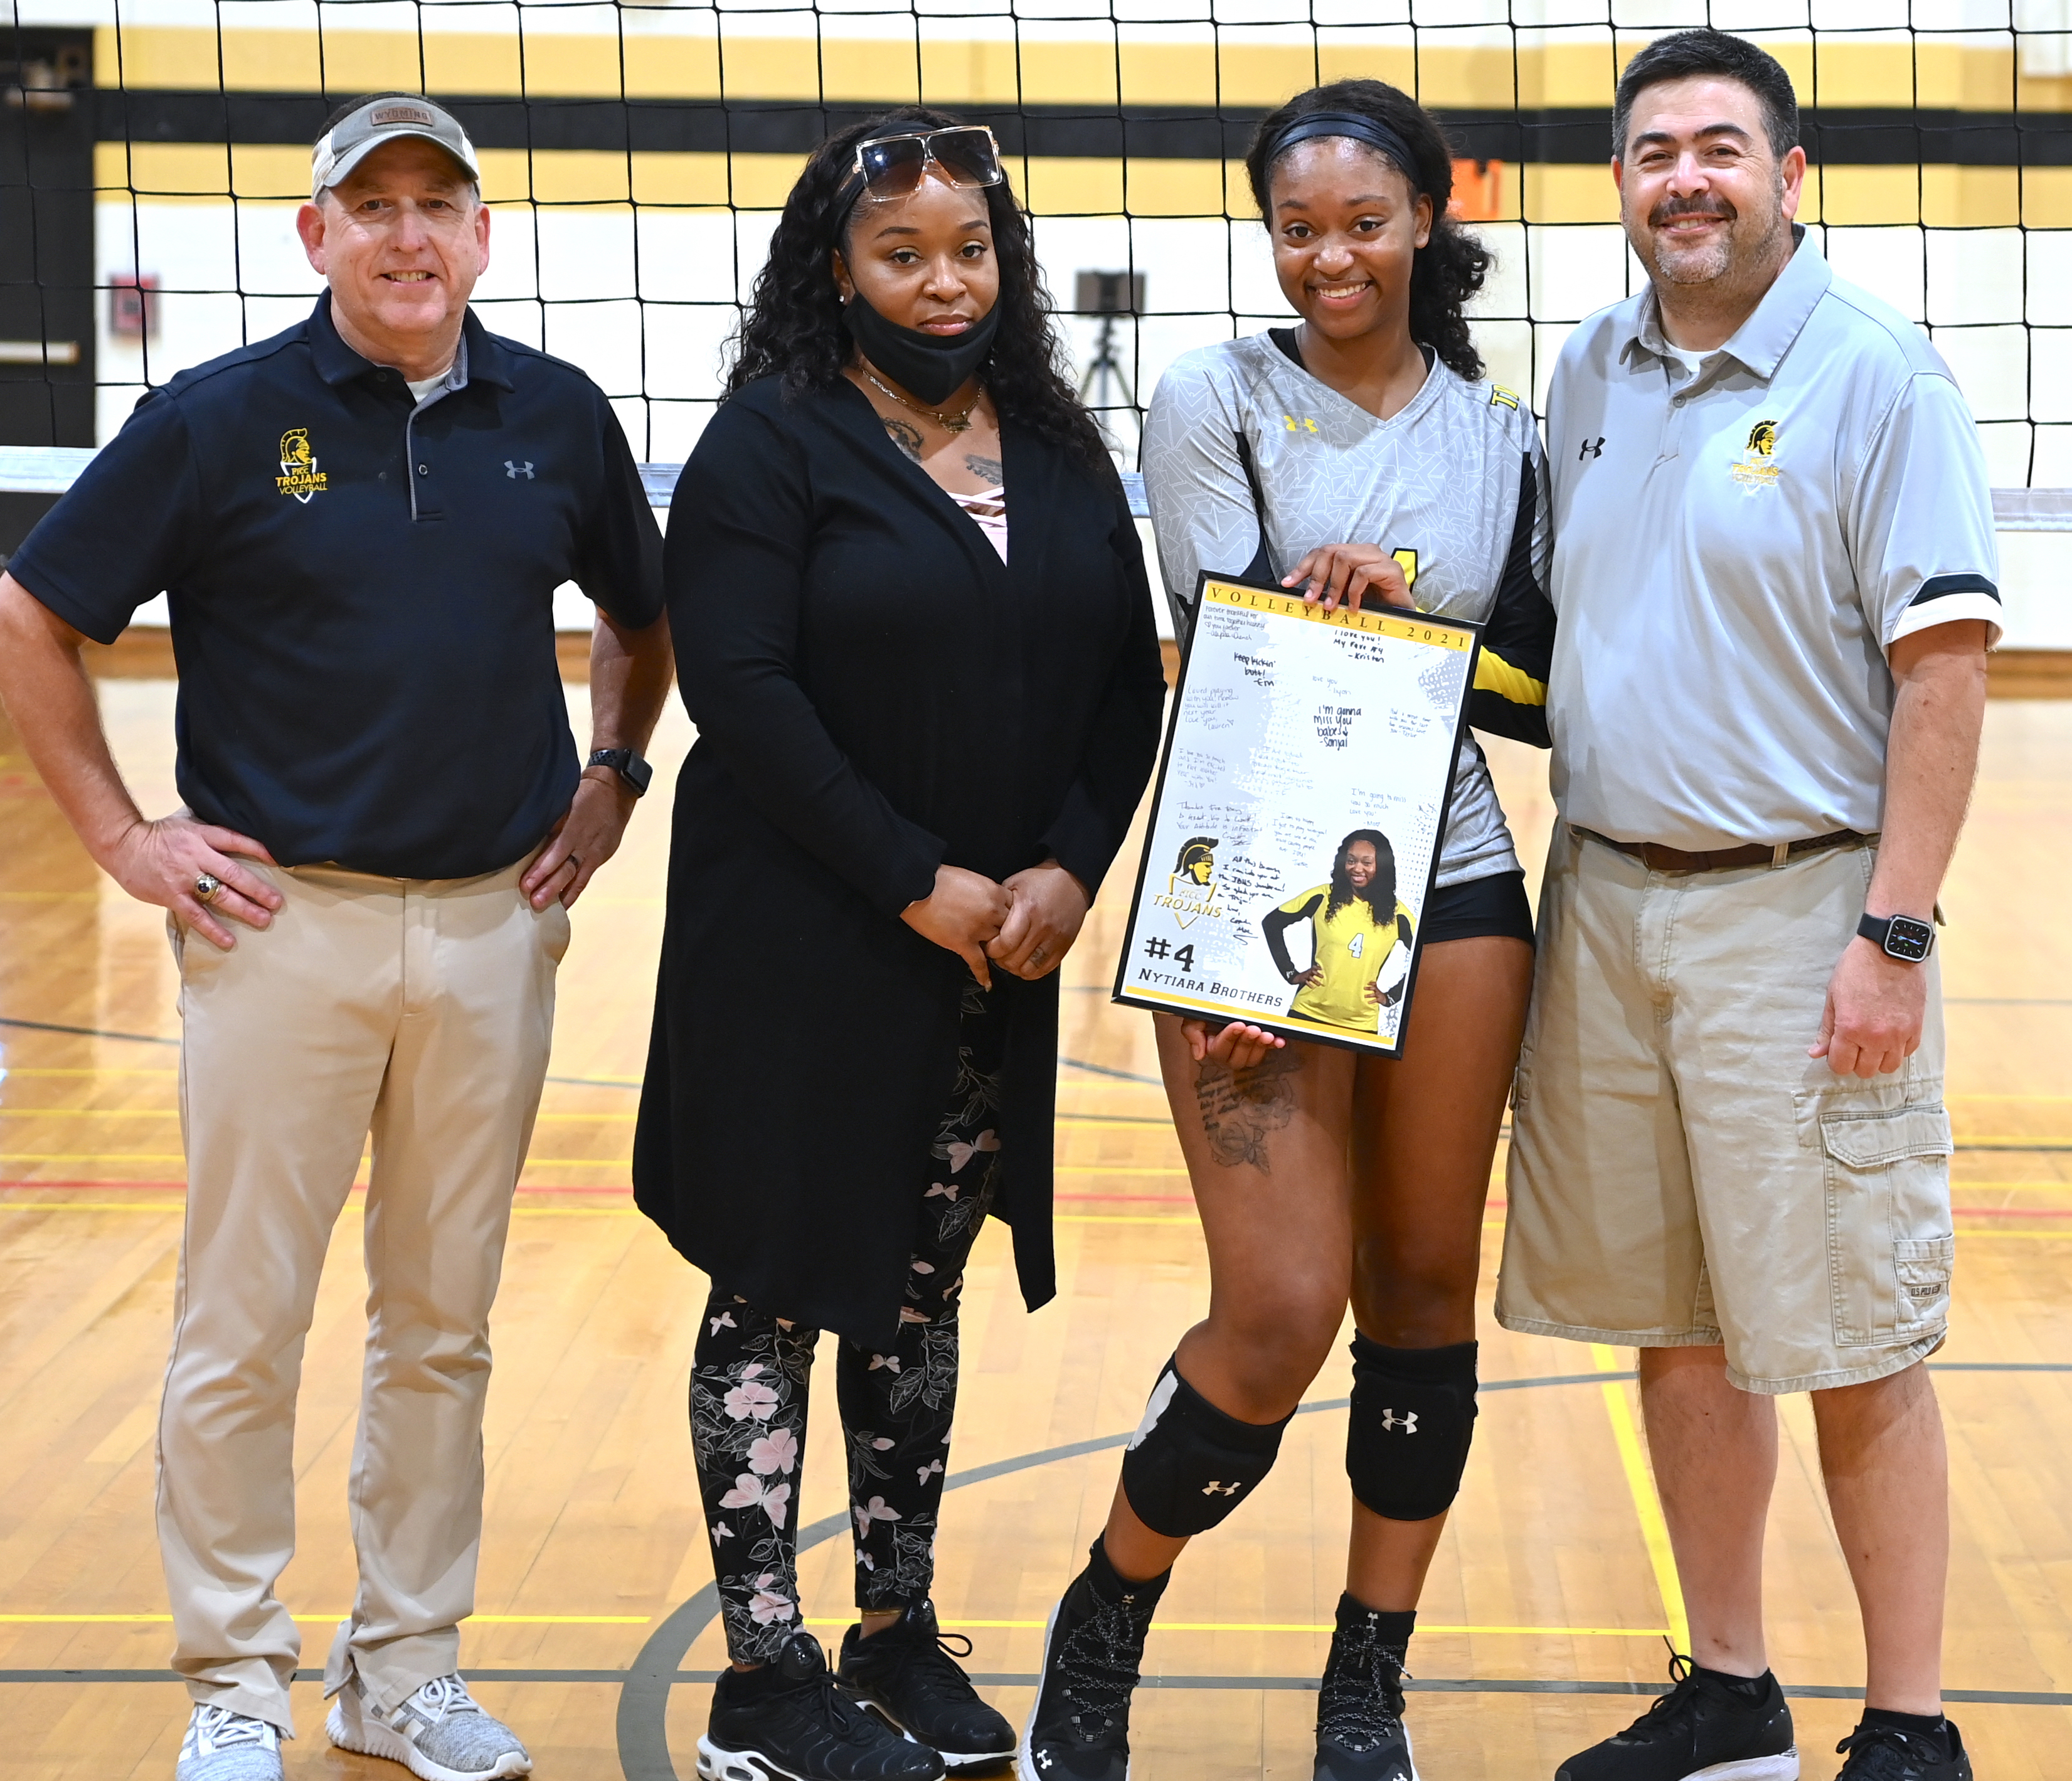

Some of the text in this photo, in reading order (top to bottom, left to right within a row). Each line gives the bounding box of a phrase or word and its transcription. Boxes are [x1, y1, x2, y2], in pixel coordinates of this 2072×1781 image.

[375, 110, 428, 120] WYOMING
[275, 473, 327, 487] TROJANS
[280, 482, 328, 495] VOLLEYBALL
[1211, 588, 1465, 647] VOLLEYBALL 2021
[1340, 630, 1357, 639] love
[1333, 638, 1346, 649] My
[1245, 667, 1266, 679] butt!
[1327, 678, 1338, 688] you
[1318, 704, 1362, 720] I'm gonna
[1313, 715, 1333, 725] miss
[1317, 725, 1342, 737] babes
[1351, 787, 1366, 796] I'm
[1369, 792, 1384, 804] going
[1153, 895, 1222, 918] TROJANS
[1347, 933, 1364, 959] 4
[1144, 937, 1194, 972] #4
